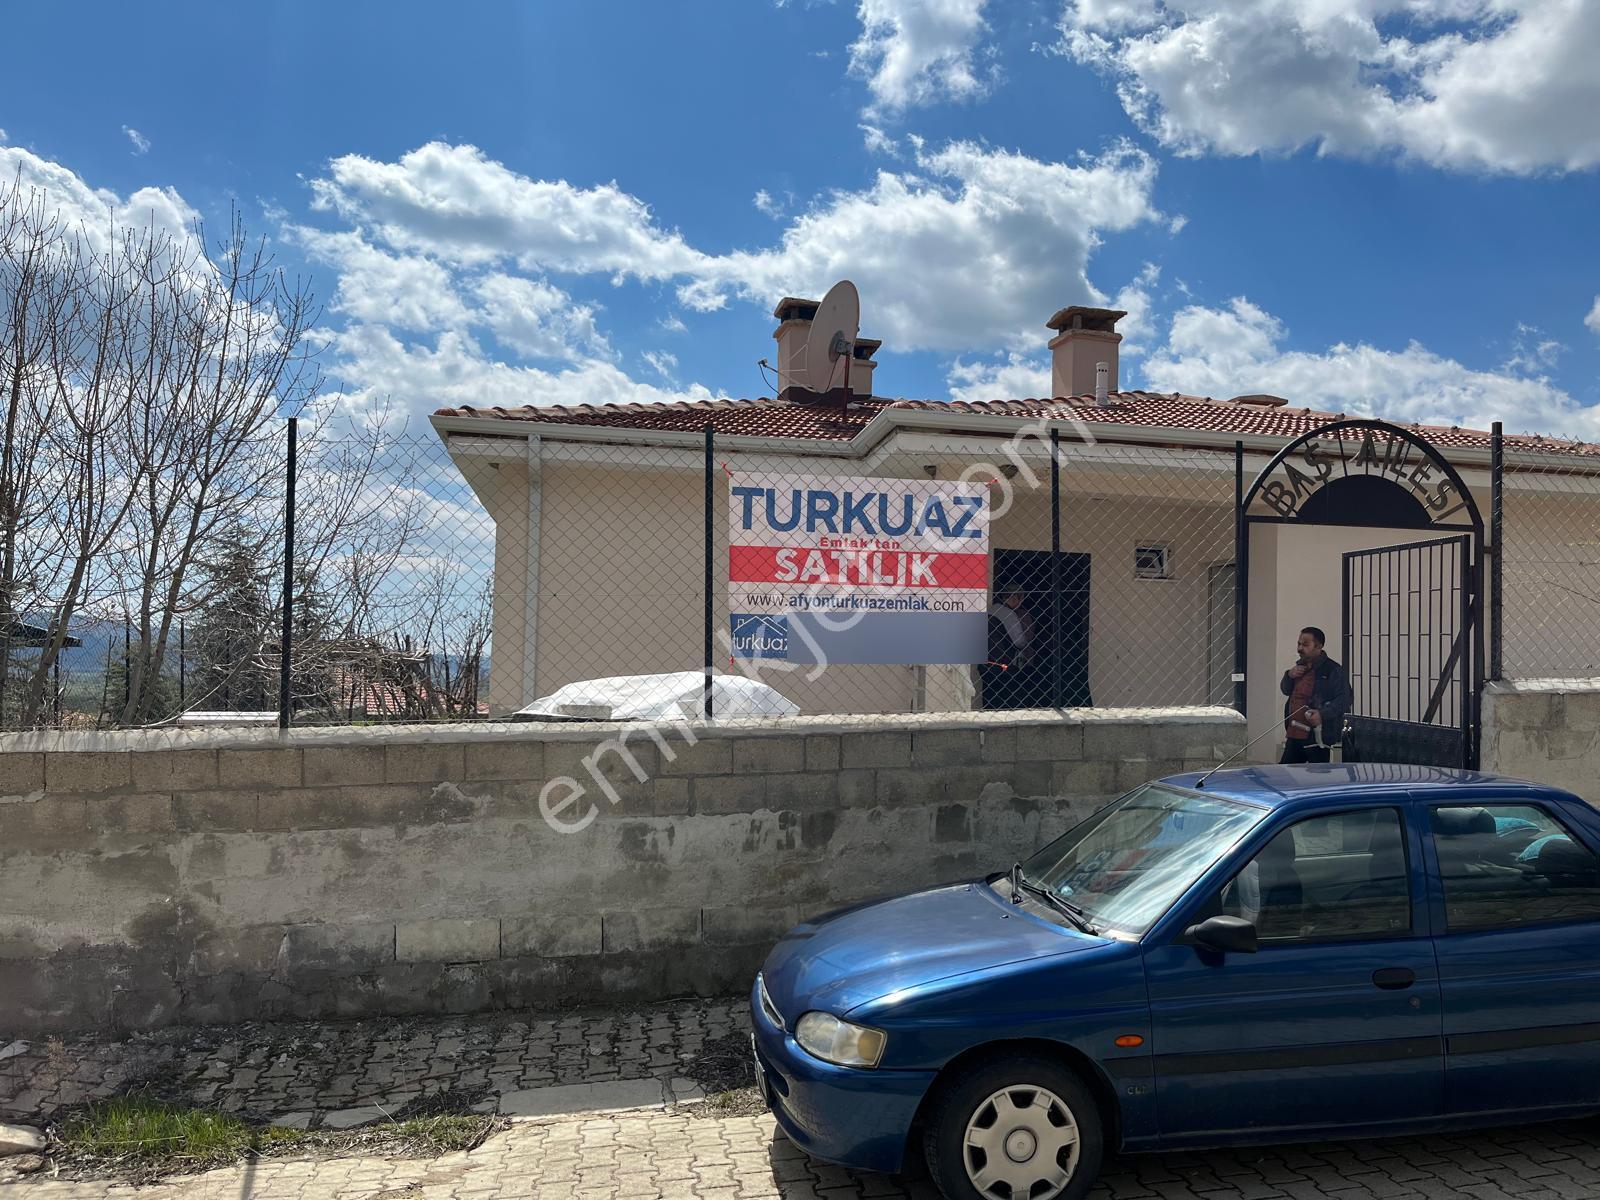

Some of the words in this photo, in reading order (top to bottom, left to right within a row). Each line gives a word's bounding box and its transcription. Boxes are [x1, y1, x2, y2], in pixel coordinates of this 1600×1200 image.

[731, 486, 983, 539] TURKUAZ
[775, 547, 938, 586] SATILIK
[747, 592, 964, 612] www.afyonturkuazemlak.com
